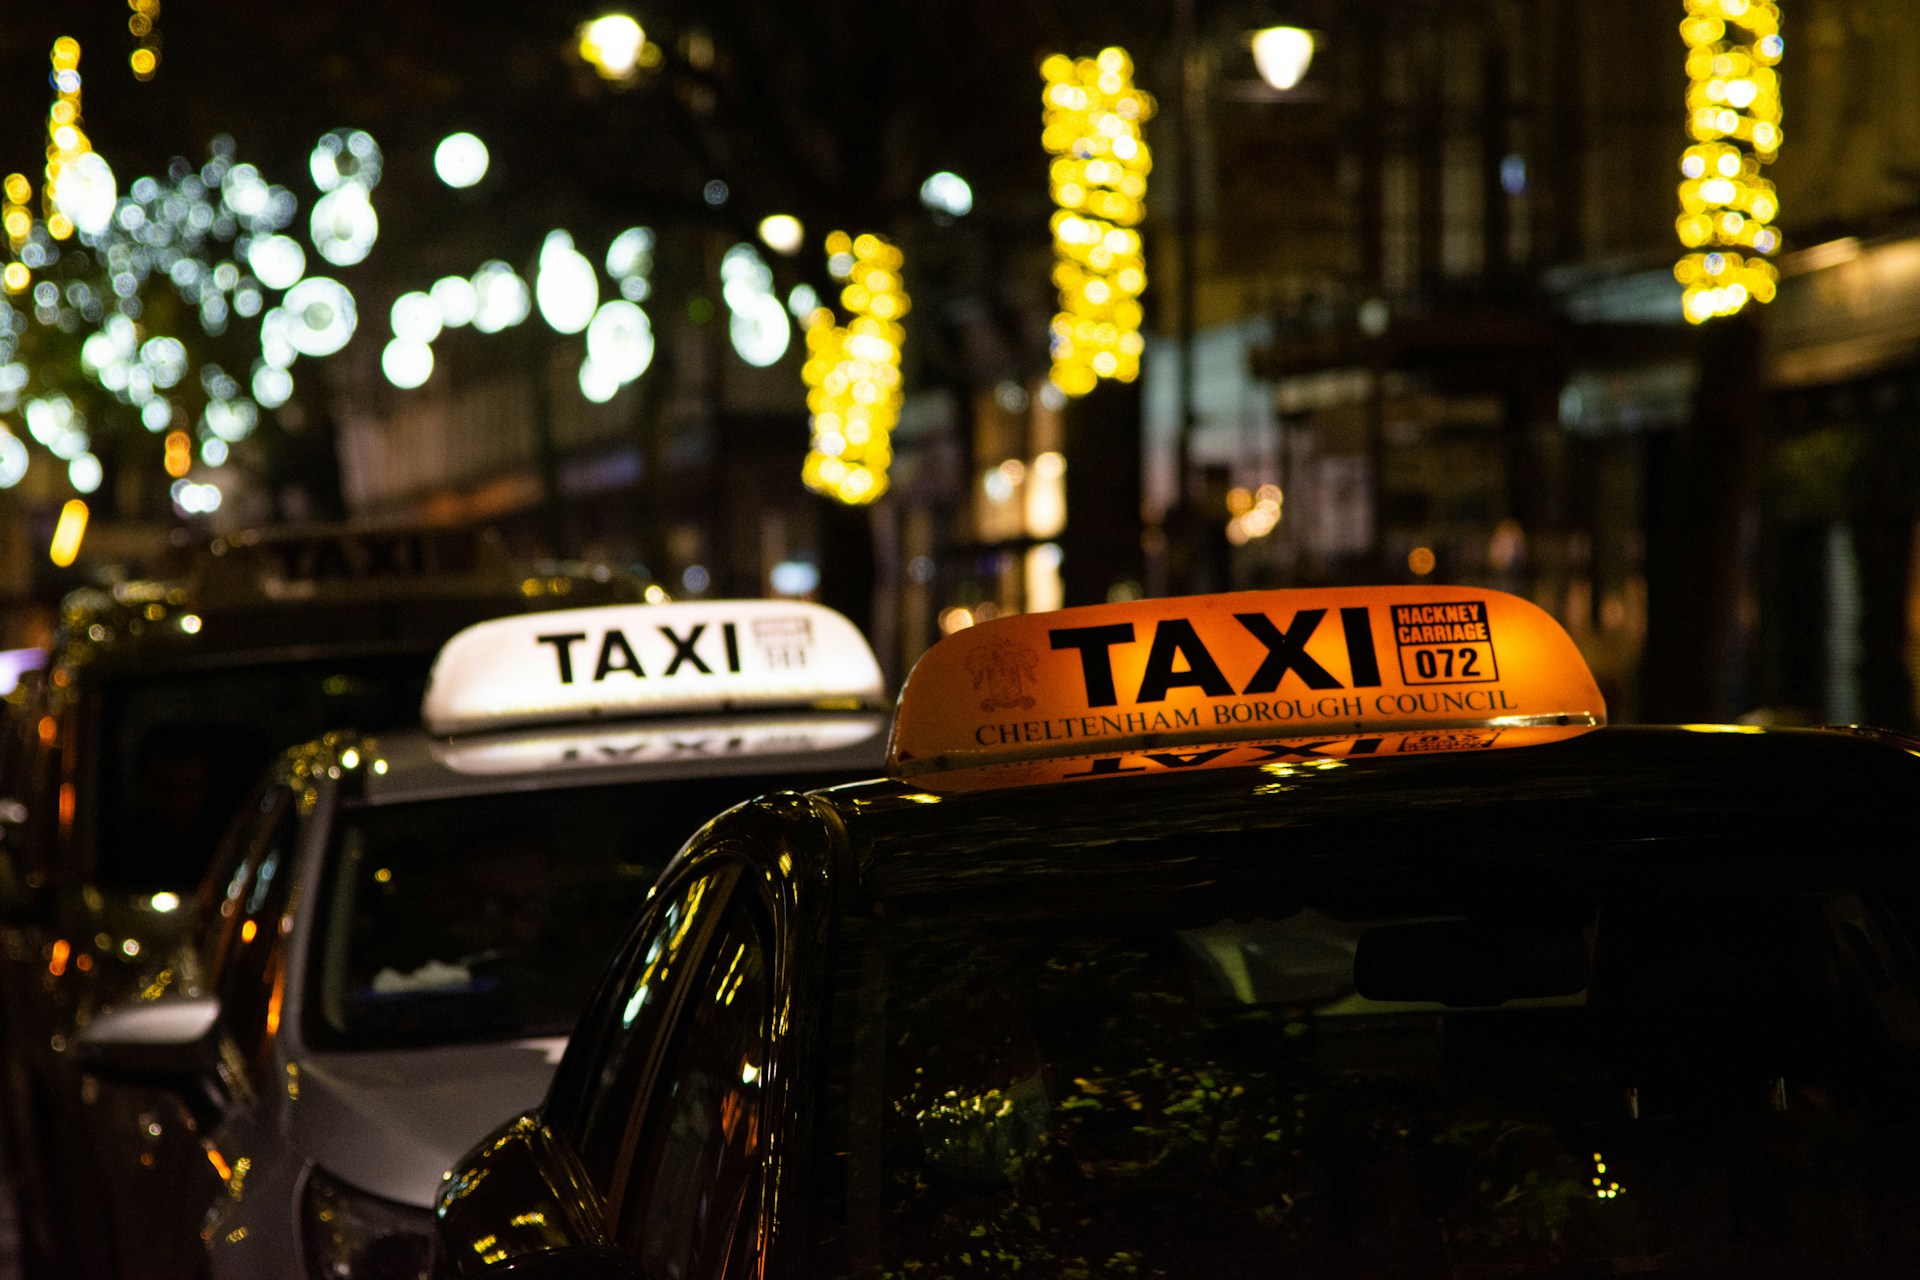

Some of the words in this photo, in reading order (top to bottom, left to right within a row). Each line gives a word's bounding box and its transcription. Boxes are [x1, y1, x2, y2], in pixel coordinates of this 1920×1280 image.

[279, 536, 424, 577] TAXI
[1397, 604, 1479, 626] HACKNEY
[1398, 622, 1488, 644] CARRIAGE
[537, 622, 742, 684] TAXI
[1050, 607, 1382, 708] TAXI
[1416, 648, 1481, 679] 072
[976, 708, 1198, 746] CHELTENHAM
[1214, 696, 1363, 725] BOROUGH
[1376, 690, 1518, 716] COUNCIL
